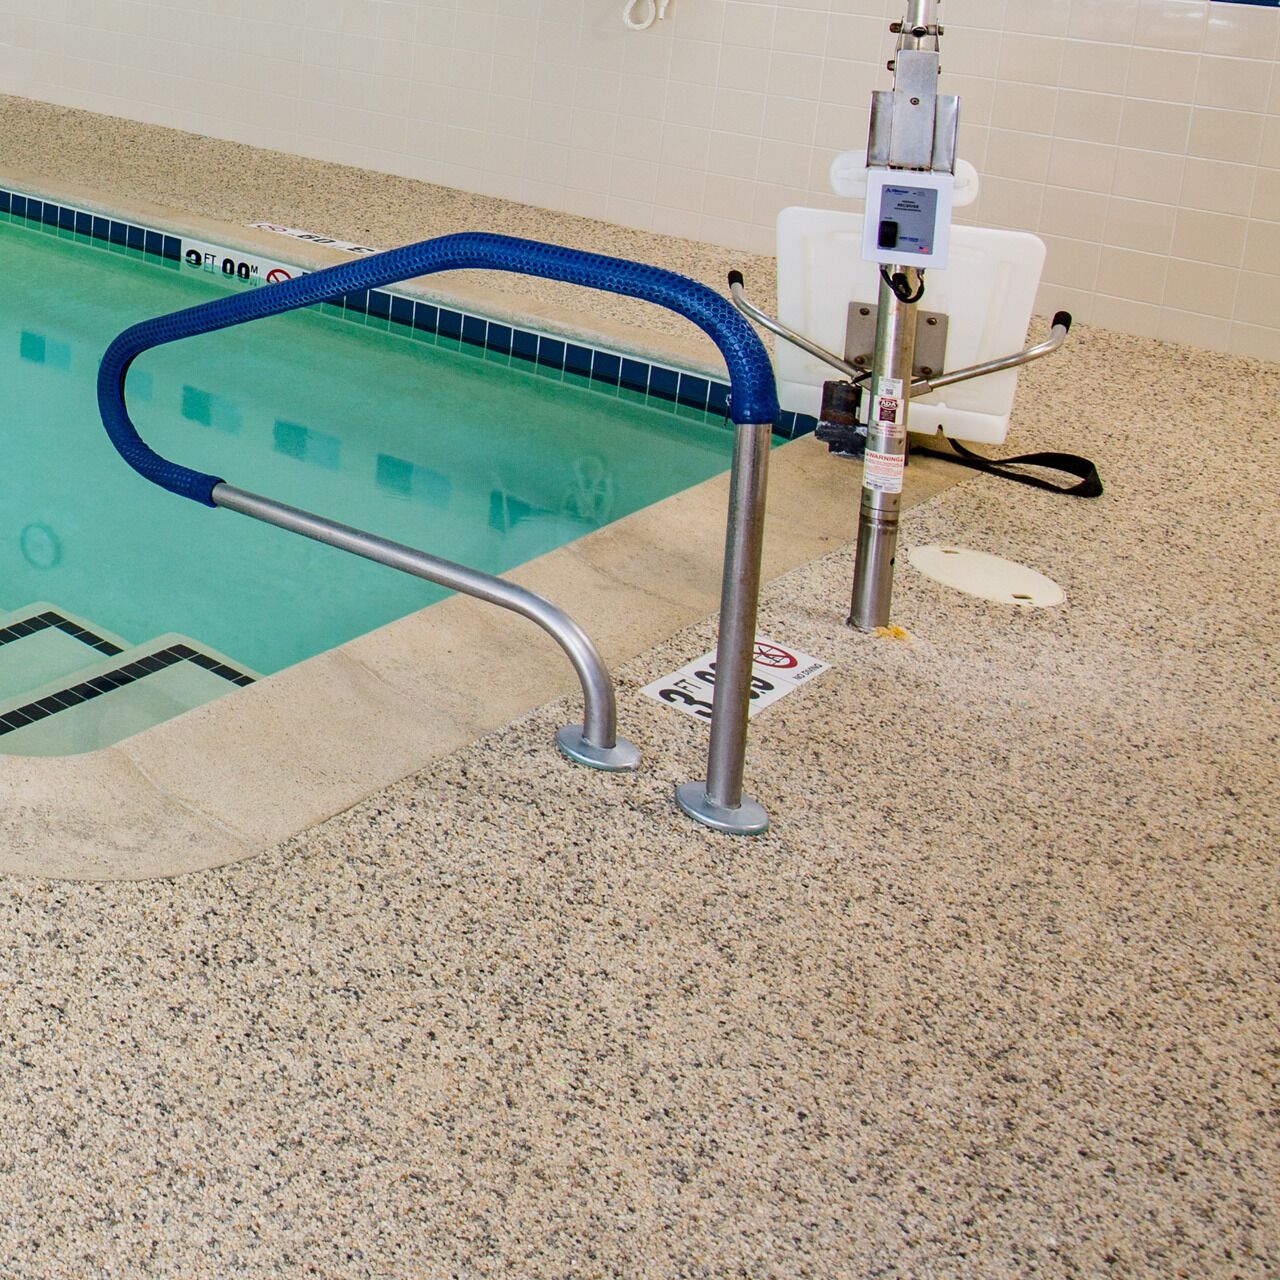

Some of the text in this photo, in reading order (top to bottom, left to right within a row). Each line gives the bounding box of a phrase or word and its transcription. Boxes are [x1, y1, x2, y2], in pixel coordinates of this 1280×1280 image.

[204, 253, 217, 265] FT
[250, 265, 259, 274] M
[868, 451, 901, 463] WARNING
[792, 663, 823, 681] NO DIVING
[658, 678, 714, 719] 3 FT
